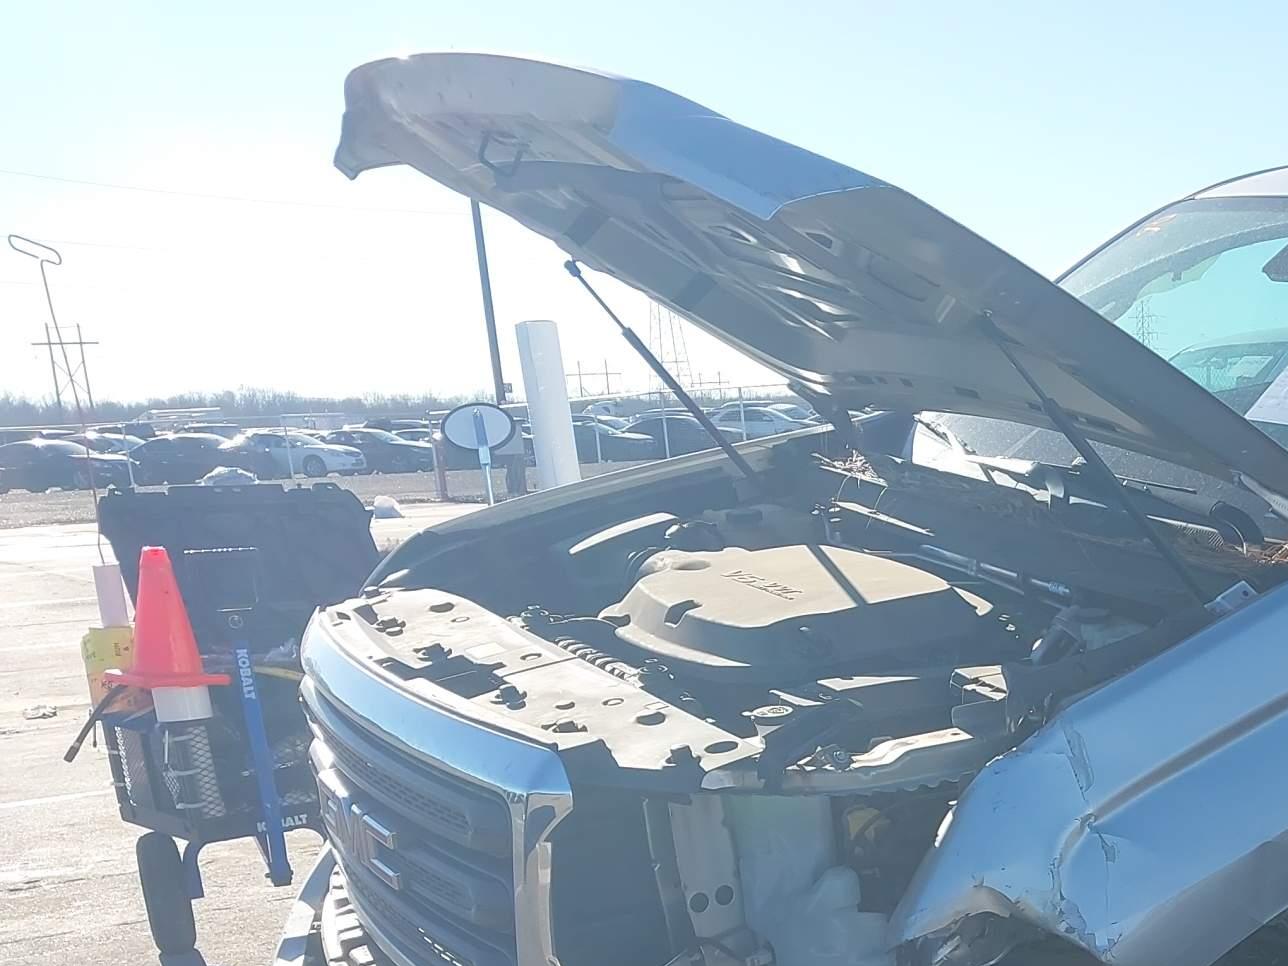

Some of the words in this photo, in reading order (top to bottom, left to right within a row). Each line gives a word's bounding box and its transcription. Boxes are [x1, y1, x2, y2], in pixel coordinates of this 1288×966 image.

[236, 648, 257, 700] KOBALT
[256, 813, 308, 833] KALT
[319, 772, 401, 891] GMC
